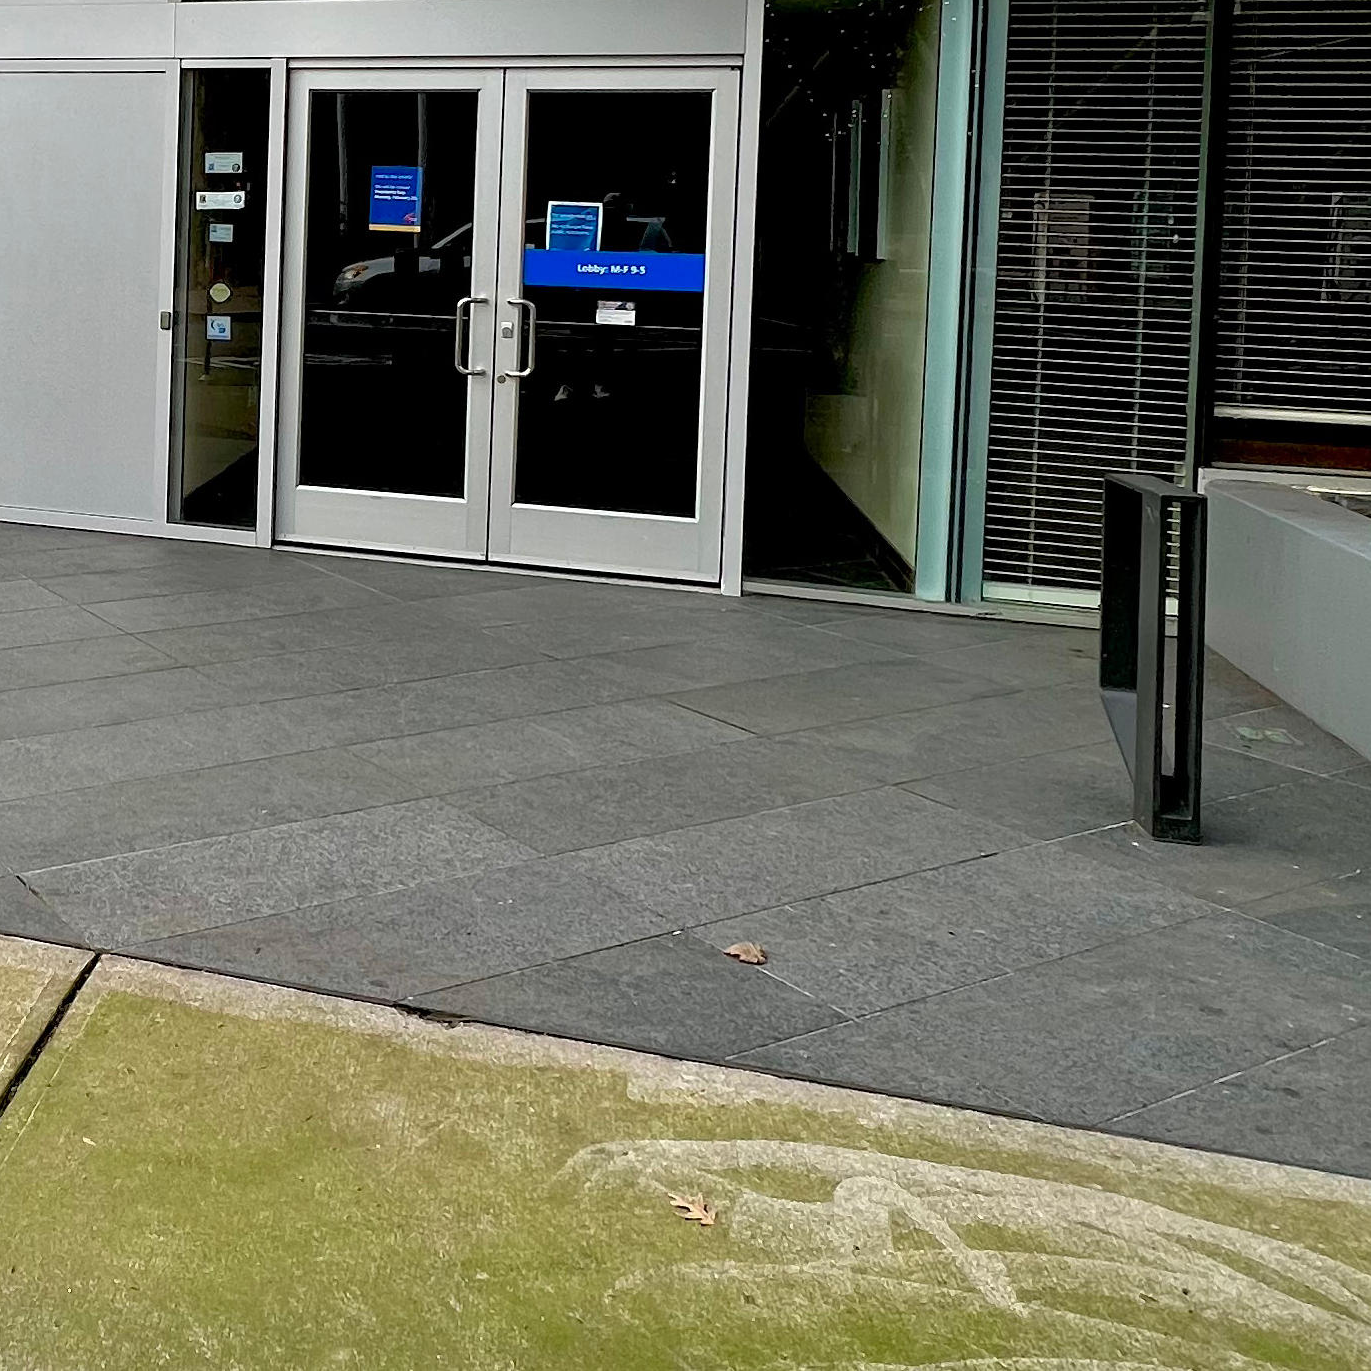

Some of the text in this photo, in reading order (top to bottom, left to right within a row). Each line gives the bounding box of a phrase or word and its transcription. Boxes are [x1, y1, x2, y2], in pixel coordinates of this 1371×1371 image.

[577, 264, 646, 275] Lobby: M-F 9-5
